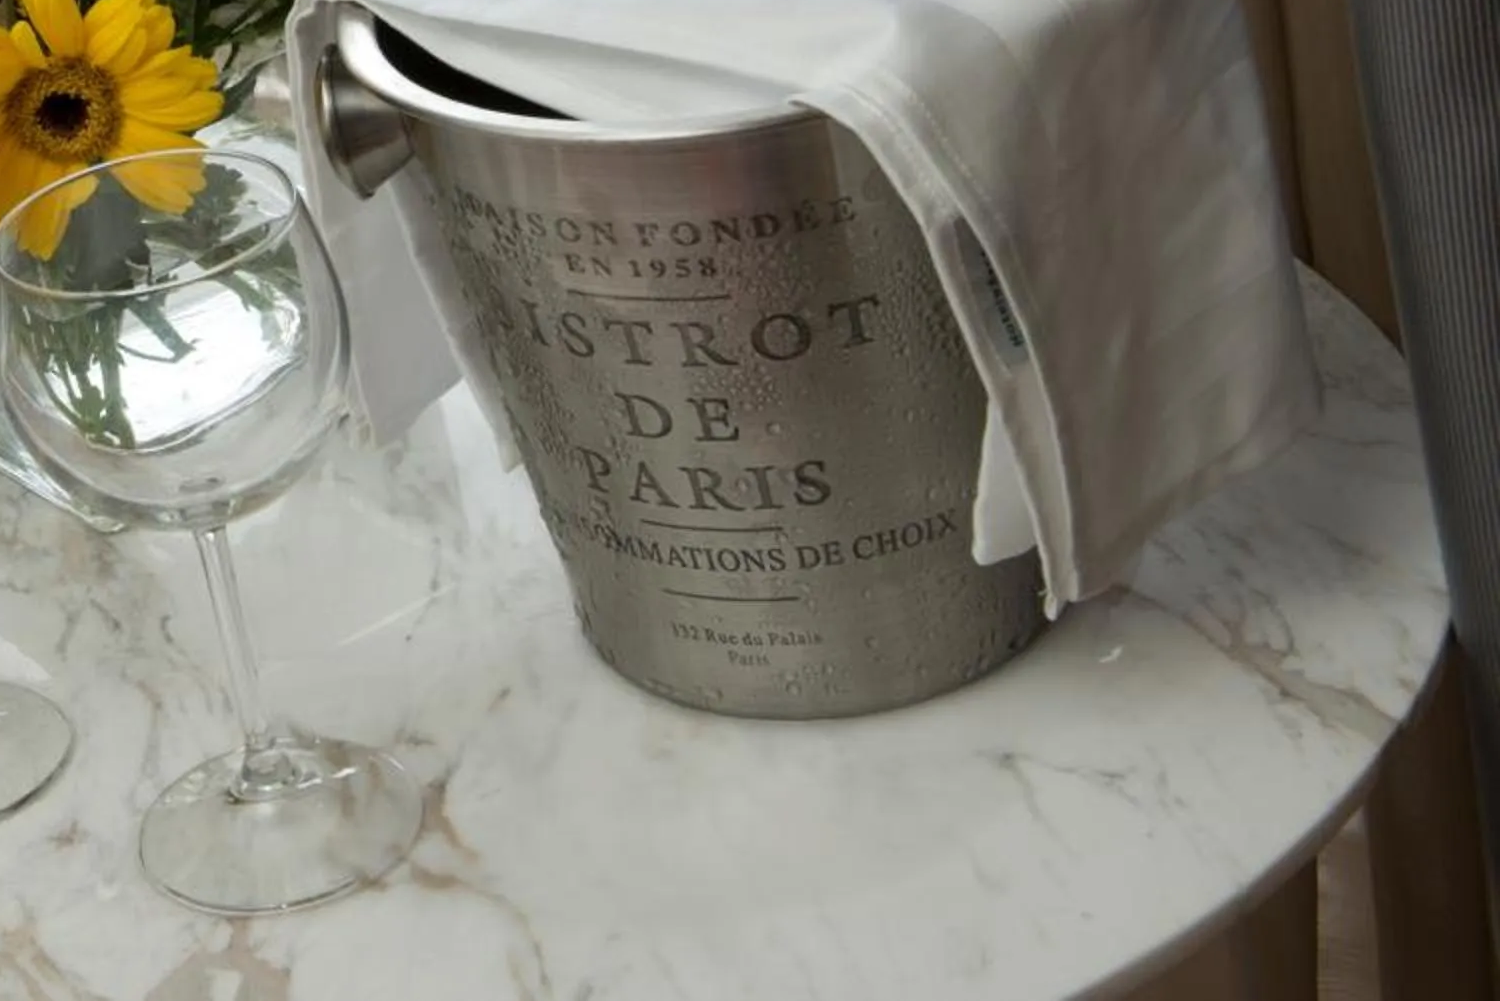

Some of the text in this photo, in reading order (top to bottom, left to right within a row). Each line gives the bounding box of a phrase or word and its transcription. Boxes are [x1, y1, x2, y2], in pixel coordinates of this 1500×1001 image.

[562, 252, 718, 279] EN 1958
[614, 391, 741, 443] DE
[575, 445, 832, 512] PARIS
[796, 541, 845, 570] DE
[852, 507, 959, 561] CHOIX
[703, 627, 739, 646] Rue
[741, 631, 764, 647] du
[727, 649, 772, 667] Paris
